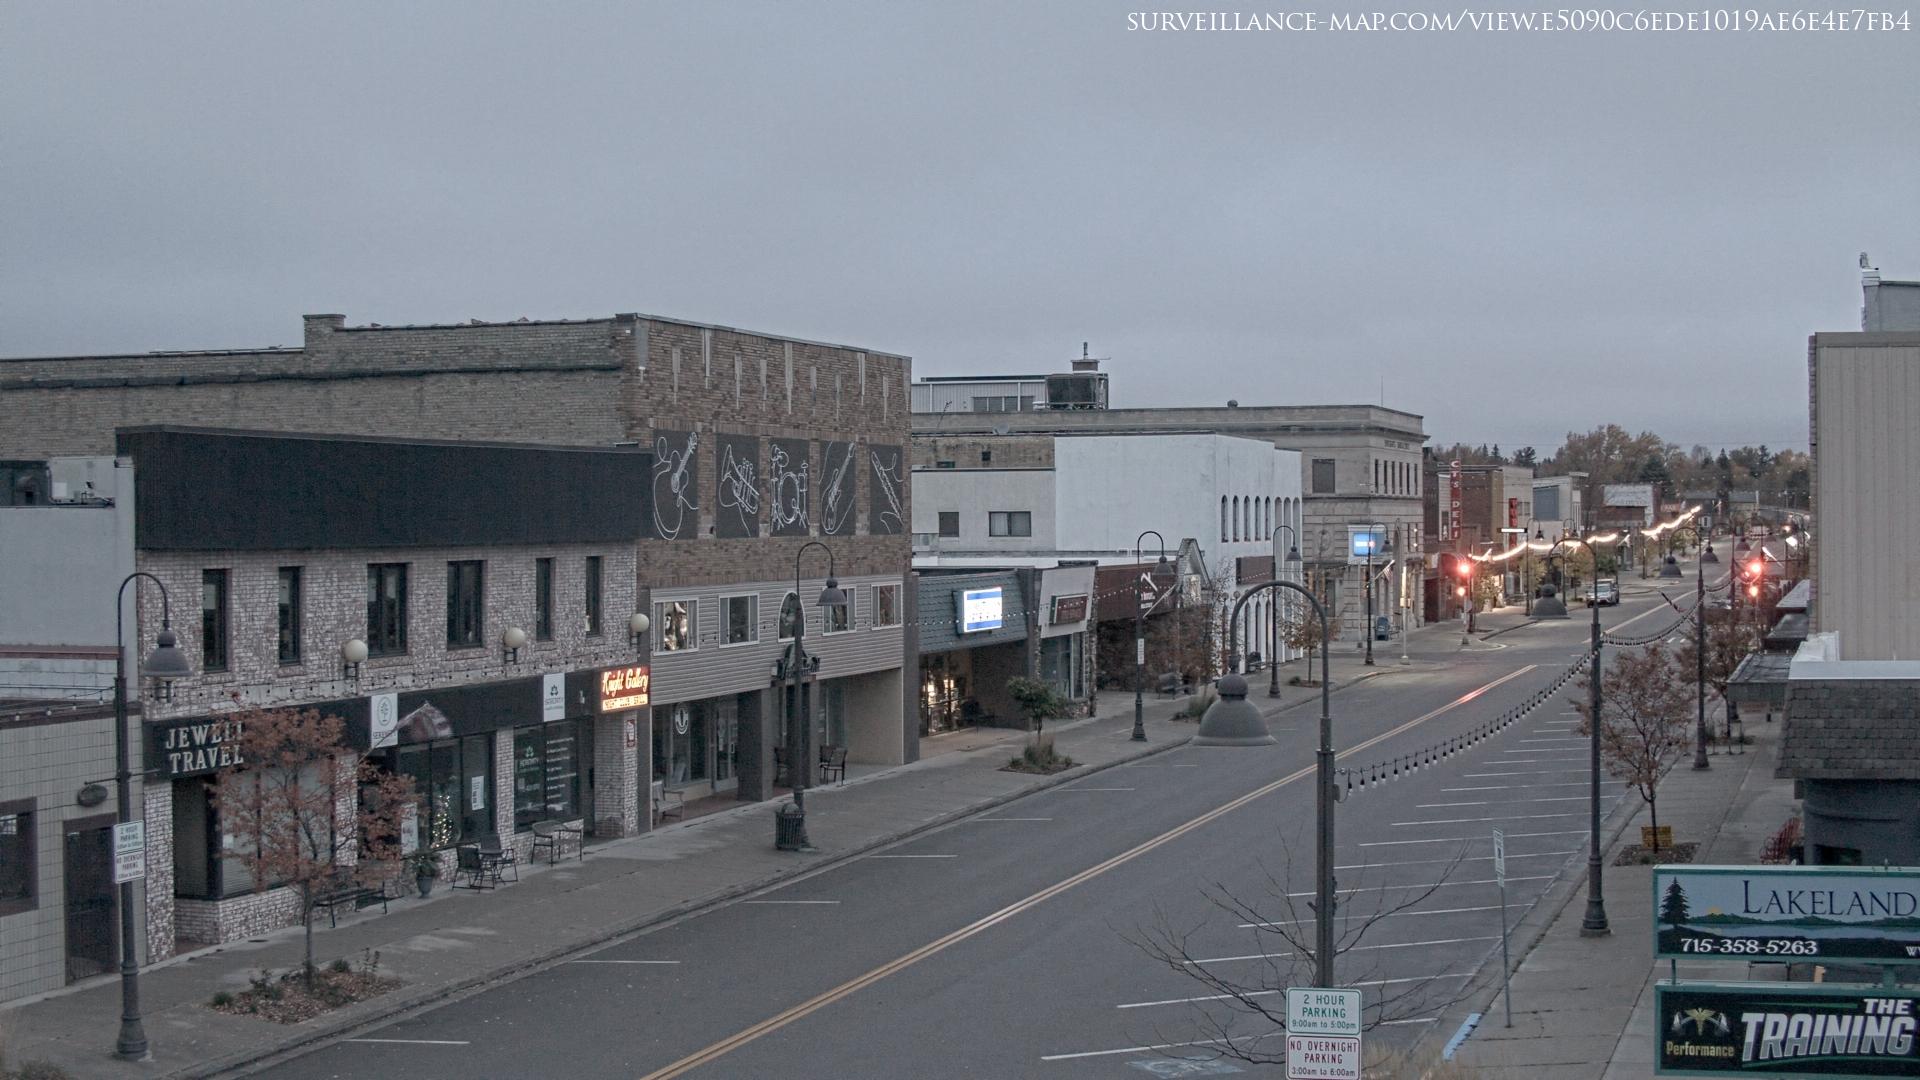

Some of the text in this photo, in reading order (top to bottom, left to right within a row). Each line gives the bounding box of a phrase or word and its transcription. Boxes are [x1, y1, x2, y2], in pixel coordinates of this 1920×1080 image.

[169, 744, 244, 774] TRAVEL
[1742, 880, 1917, 917] LAKELAND
[1681, 938, 1818, 955] 715-358-5263
[1303, 994, 1345, 1006] 2 HOUR
[1863, 998, 1912, 1015] THE
[1302, 1007, 1346, 1018] PARKING
[1291, 1019, 1357, 1030] 9:00am to 5:00pm
[1741, 1012, 1916, 1062] TRAINING
[1290, 1041, 1357, 1053] NO OVERNIGHT
[1666, 1041, 1735, 1057] Performance
[1304, 1053, 1343, 1064] PARKING
[1320, 1067, 1327, 1075] to
